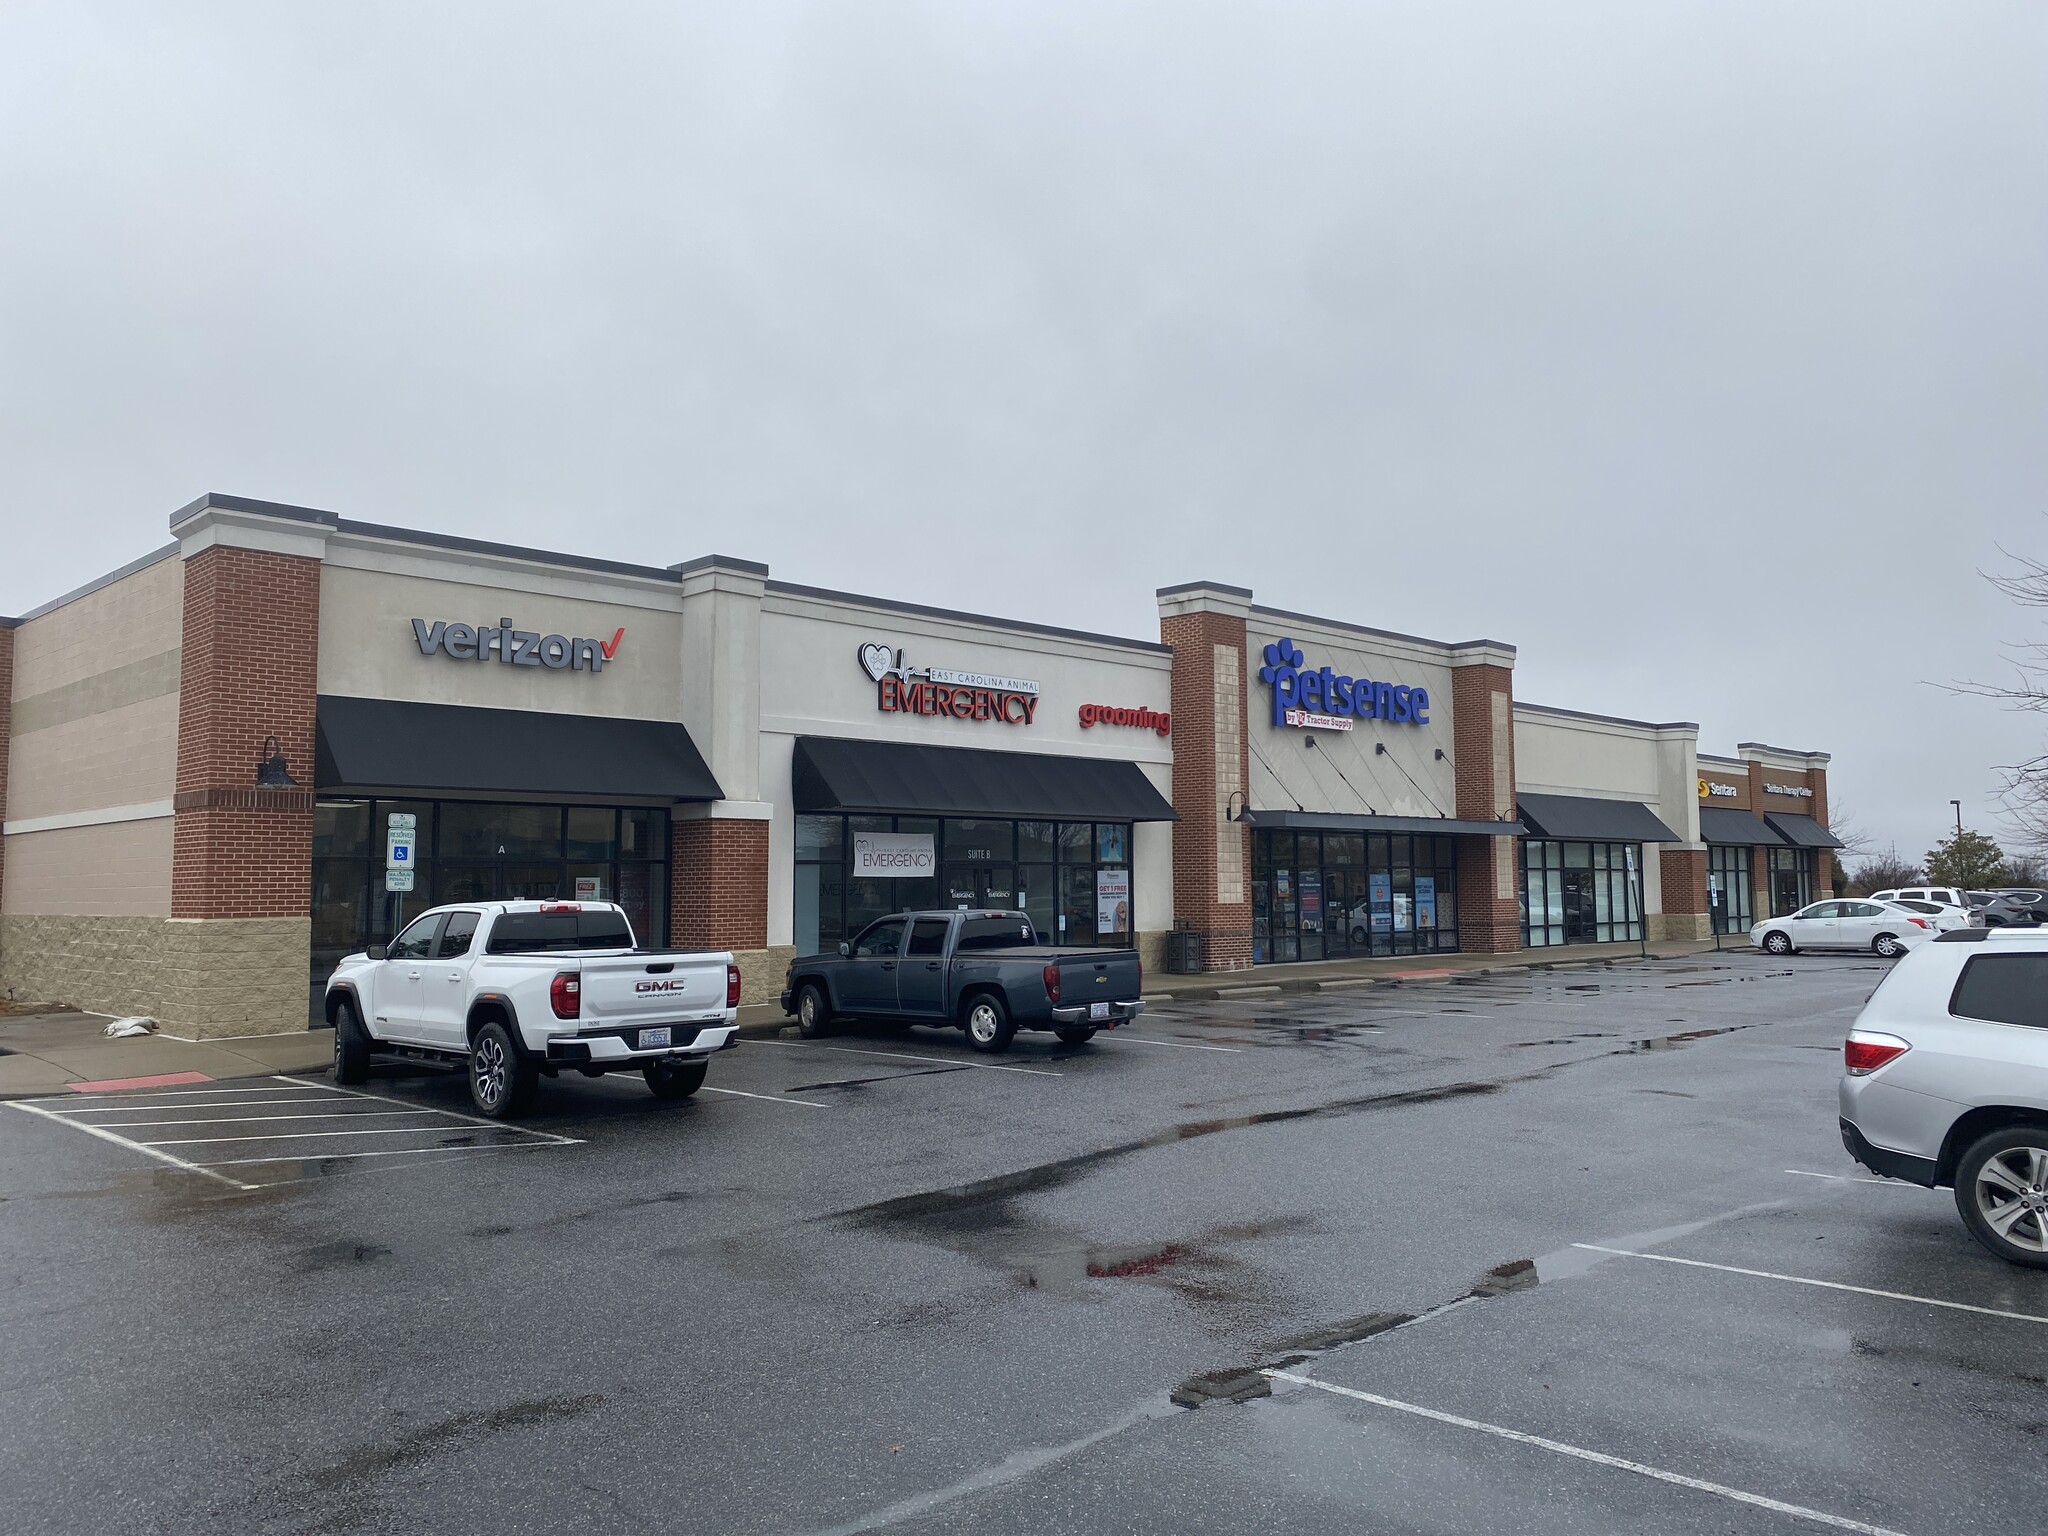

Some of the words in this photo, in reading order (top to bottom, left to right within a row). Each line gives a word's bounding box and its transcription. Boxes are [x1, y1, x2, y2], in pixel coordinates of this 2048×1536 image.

[411, 617, 602, 672] verizon
[931, 669, 953, 681] EAST
[958, 674, 1003, 687] CAROLINA
[1007, 680, 1038, 692] ANIMAL
[878, 679, 1039, 725] EMERGENCY
[1272, 665, 1429, 727] petsense
[1078, 704, 1171, 736] grooming
[1287, 713, 1296, 723] by
[1307, 715, 1330, 726] Tractor
[1331, 718, 1352, 729] Supply
[1710, 783, 1737, 796] Sentara
[498, 845, 505, 854] A
[968, 849, 985, 859] SUITE
[986, 850, 991, 859] B
[863, 853, 933, 867] EMERGENCY
[635, 980, 685, 992] GMC
